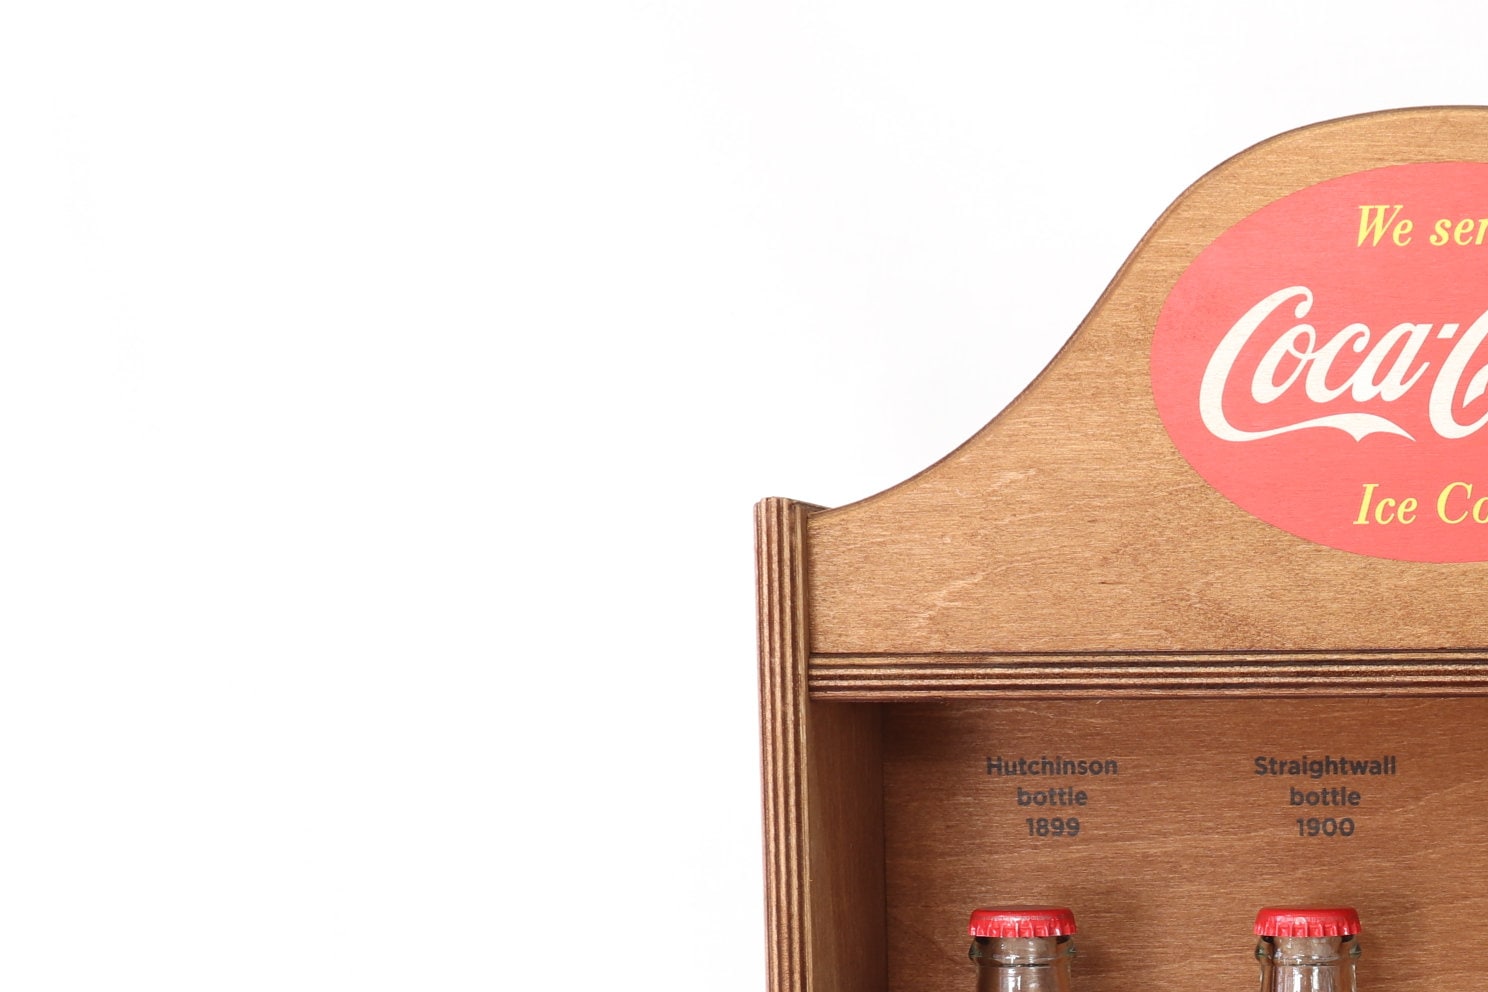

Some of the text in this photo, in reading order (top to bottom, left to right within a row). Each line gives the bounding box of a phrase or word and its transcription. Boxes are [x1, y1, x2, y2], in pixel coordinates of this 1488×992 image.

[1355, 204, 1412, 248] We
[1353, 483, 1418, 525] Ice
[986, 755, 1118, 777] Hutchinson
[1254, 755, 1396, 779] Straightwall
[1016, 786, 1087, 807] bottle
[1289, 786, 1361, 807] bottle
[1025, 817, 1080, 837] 1899
[1296, 817, 1355, 837] 1900
